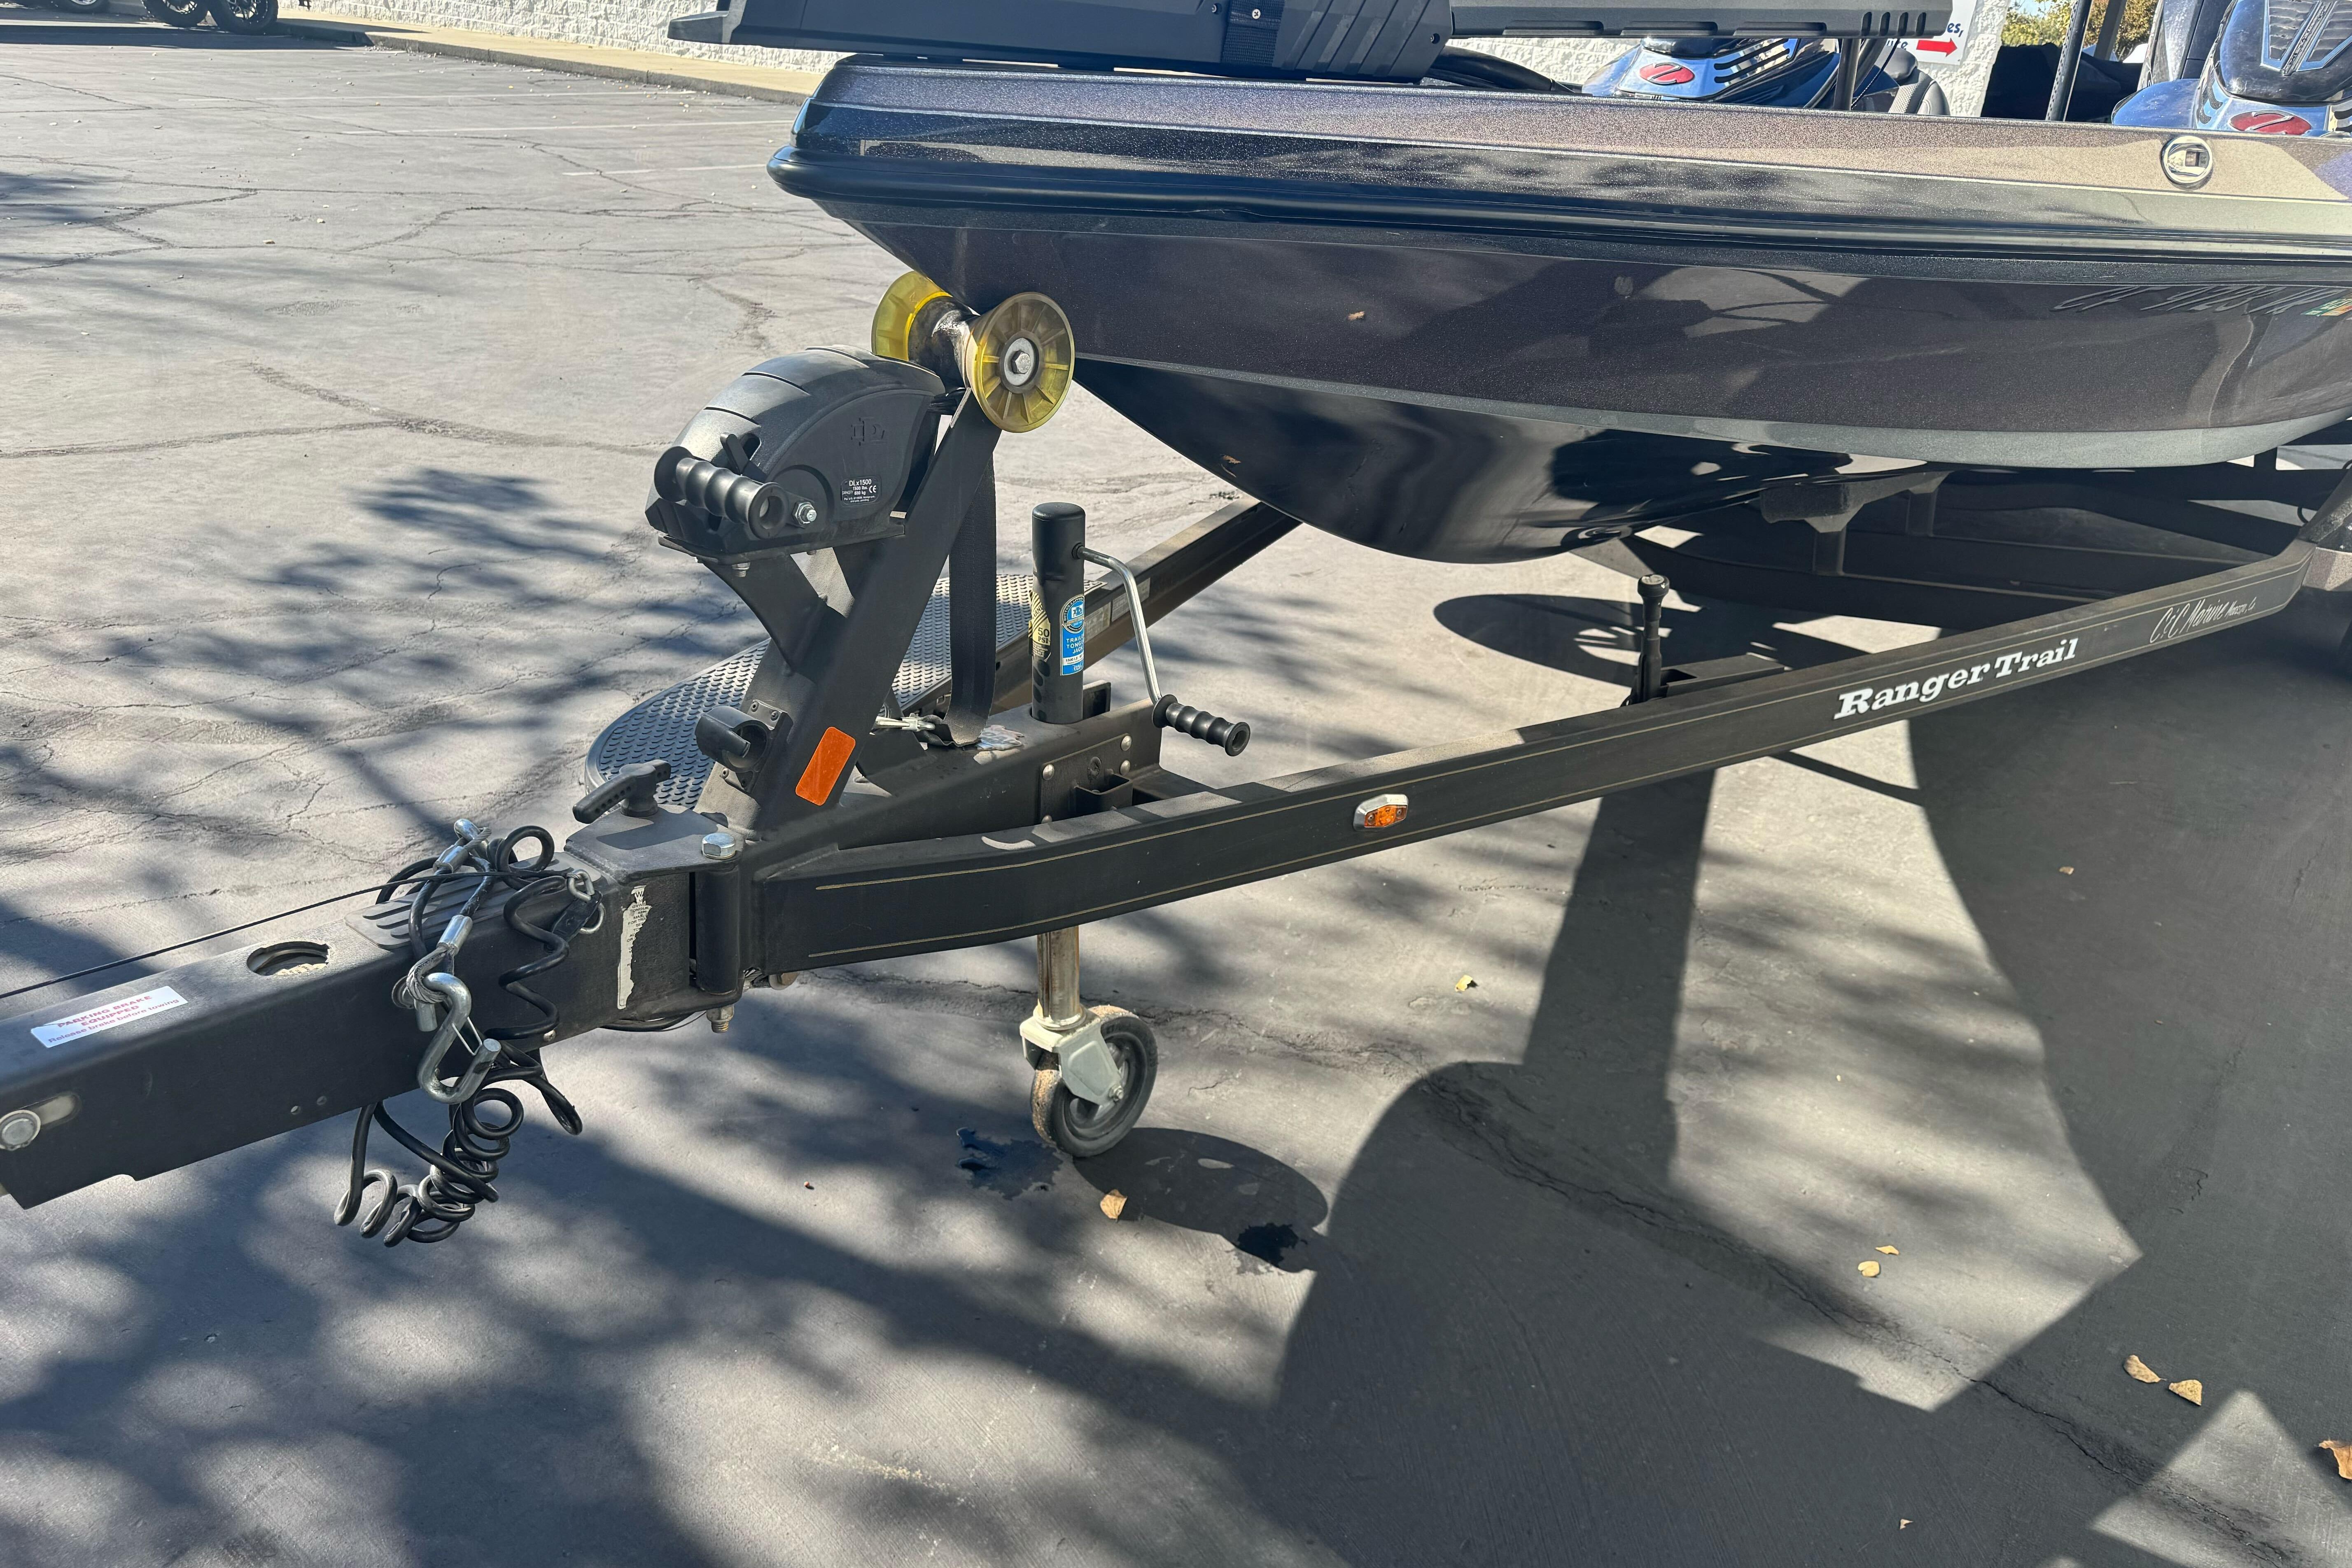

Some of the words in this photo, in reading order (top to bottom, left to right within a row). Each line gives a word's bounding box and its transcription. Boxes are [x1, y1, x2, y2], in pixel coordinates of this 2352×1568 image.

[1038, 627, 1050, 637] 50
[2179, 598, 2230, 634] Marine
[1833, 663, 1990, 720] Ranger
[1994, 637, 2079, 679] Trail
[48, 1028, 87, 1043] Release
[88, 1019, 116, 1030] brake
[118, 1009, 147, 1021] before
[148, 999, 180, 1011] towing
[58, 1009, 111, 1028] PARKING
[113, 995, 152, 1010] BRAKE
[81, 1005, 140, 1027] EQUIPPED
